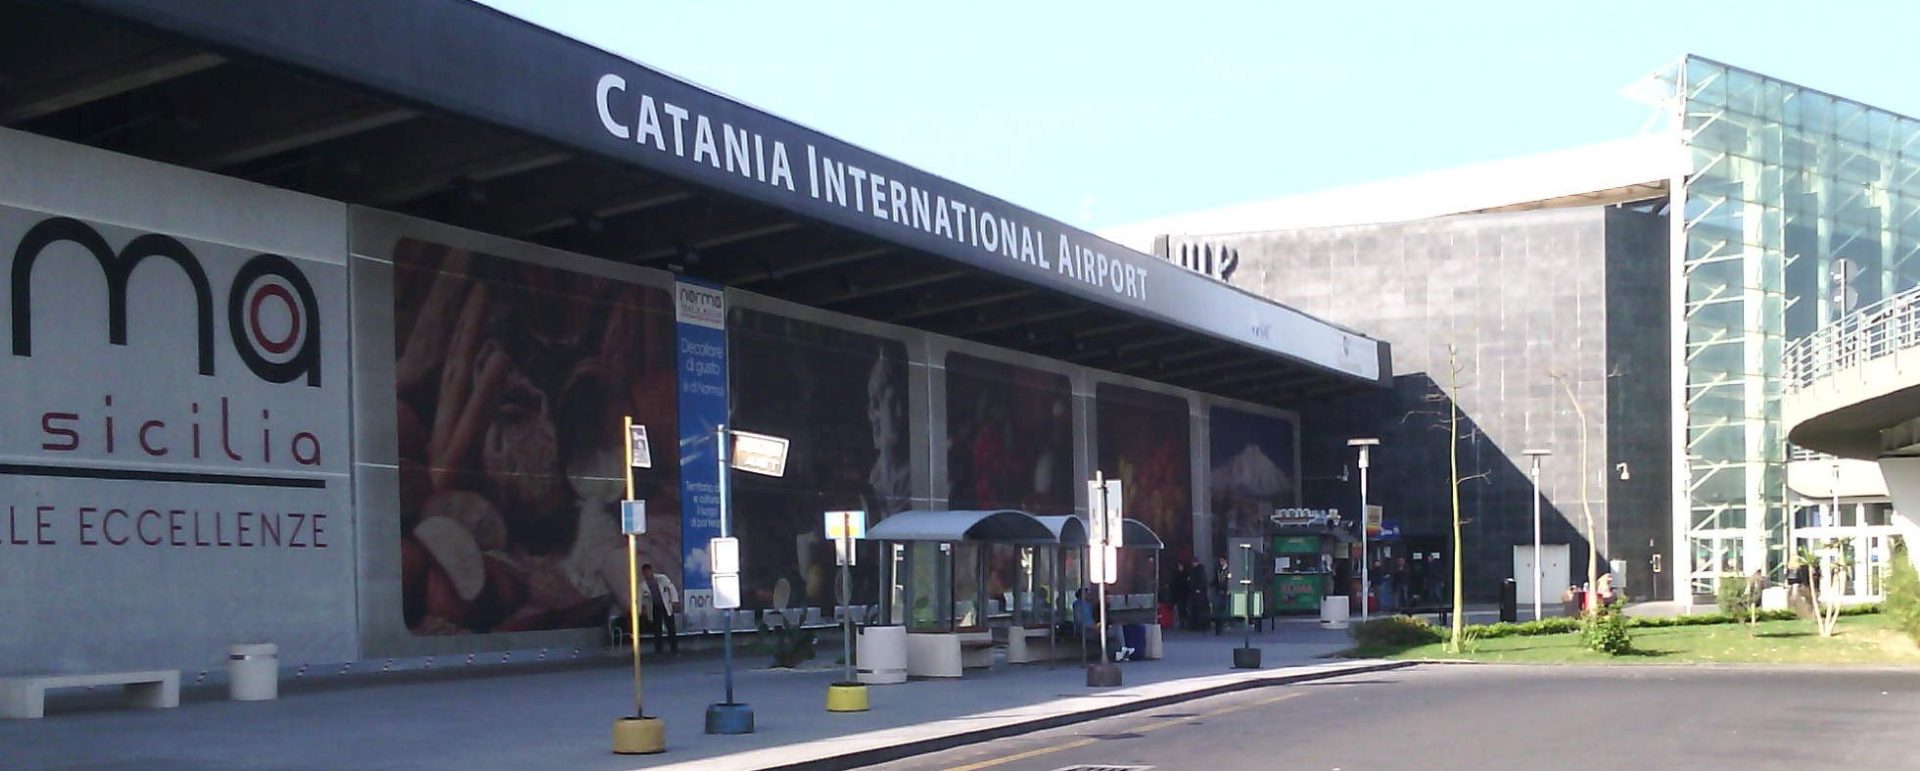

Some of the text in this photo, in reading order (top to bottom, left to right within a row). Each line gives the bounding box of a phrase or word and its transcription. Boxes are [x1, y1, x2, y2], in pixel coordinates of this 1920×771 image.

[596, 73, 796, 192] CATANIA
[806, 144, 1050, 270] INTERNATIONAL
[1057, 233, 1148, 301] AIRPORT
[680, 289, 722, 308] norma
[41, 394, 322, 466] sicilia
[0, 504, 328, 548] LE ECCELLENZE
